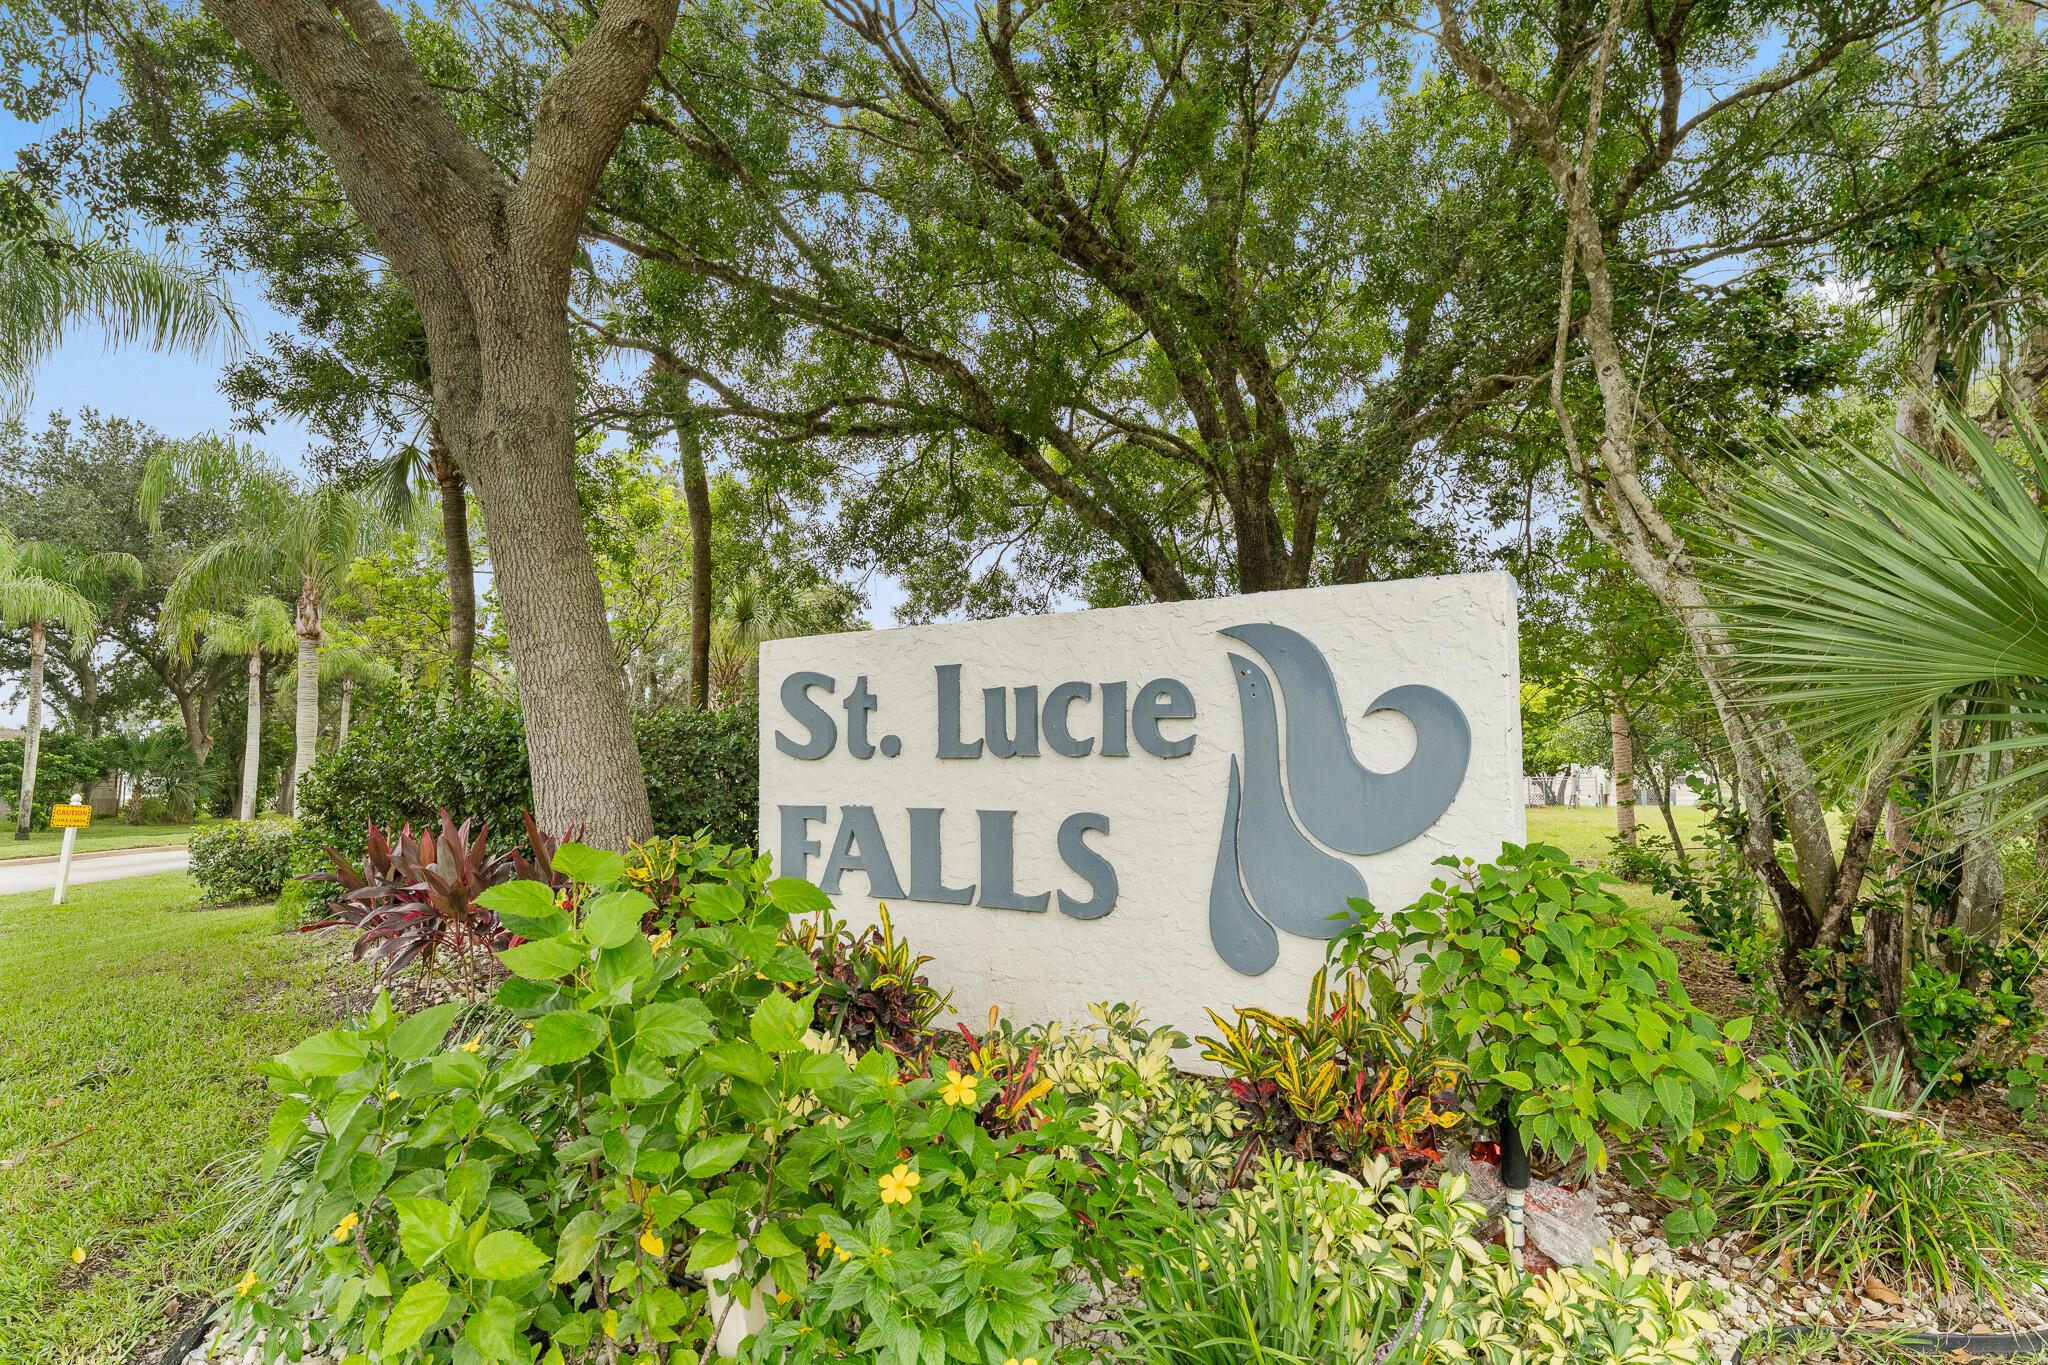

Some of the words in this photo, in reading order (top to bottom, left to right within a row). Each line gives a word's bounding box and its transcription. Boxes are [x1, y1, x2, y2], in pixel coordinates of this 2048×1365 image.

[774, 671, 902, 761] St.
[934, 663, 1197, 759] Lucie
[777, 804, 1119, 920] FALLS
